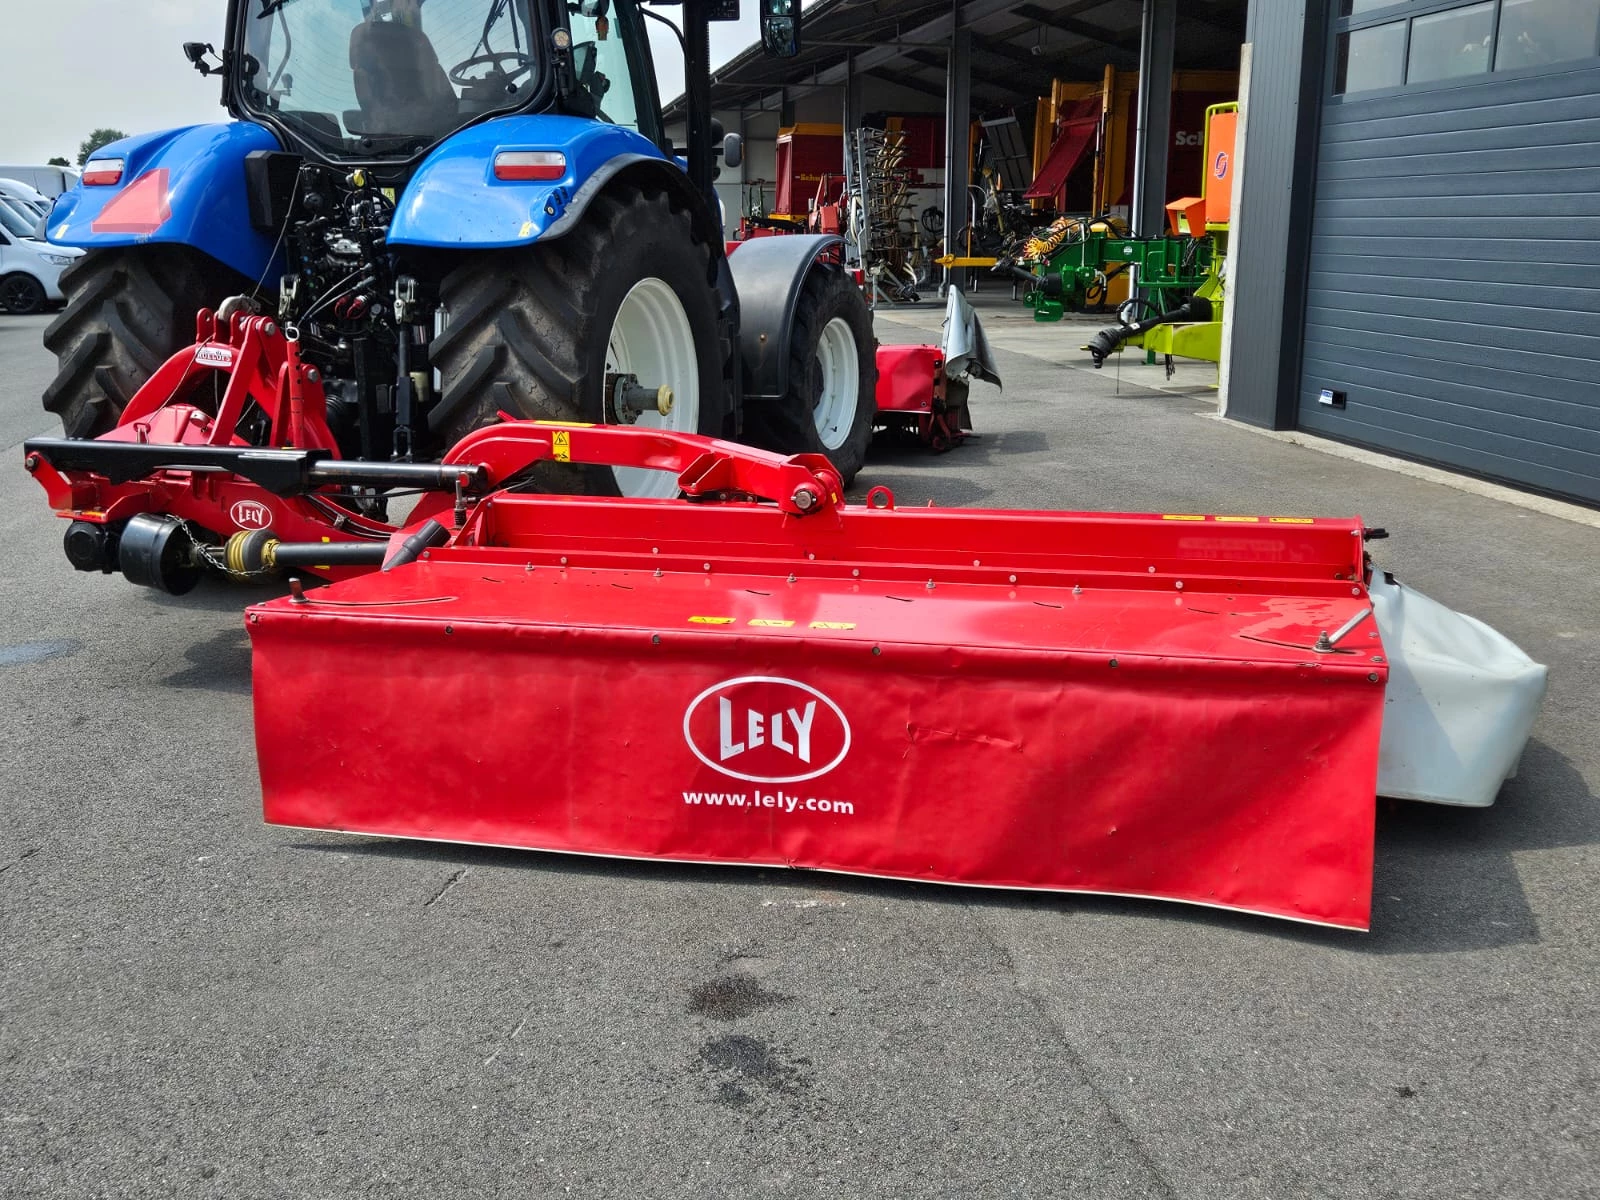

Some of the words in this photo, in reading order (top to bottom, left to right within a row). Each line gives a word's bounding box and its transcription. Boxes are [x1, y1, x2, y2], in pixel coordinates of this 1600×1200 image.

[238, 504, 265, 526] LELY
[714, 696, 817, 764] LELY
[682, 790, 854, 815] www.lely.com
